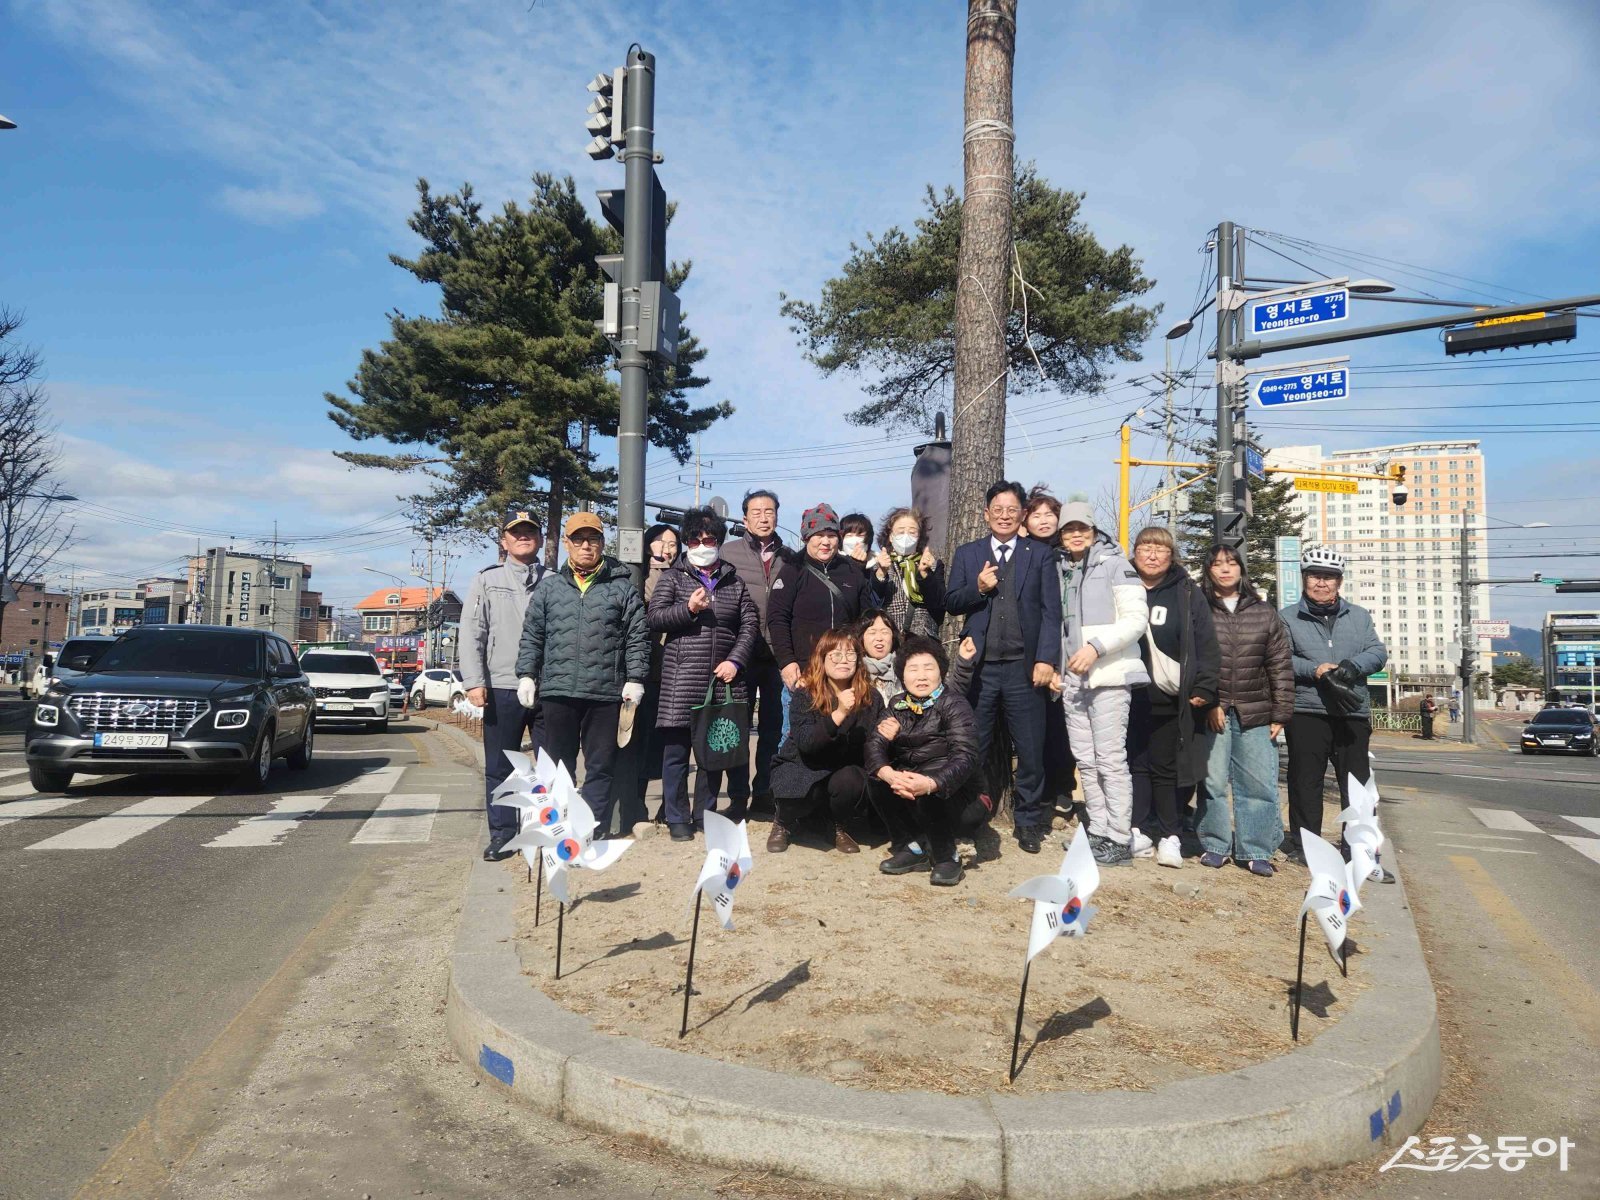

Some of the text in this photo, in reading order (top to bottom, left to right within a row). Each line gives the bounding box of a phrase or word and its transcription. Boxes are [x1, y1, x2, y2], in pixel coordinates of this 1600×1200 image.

[1266, 299, 1312, 319] 영서로
[1261, 313, 1320, 329] Yeongseo-ro
[1300, 372, 1343, 390] 영서로
[1283, 388, 1344, 401] Yeongseo-ro
[1322, 482, 1337, 491] CCTV
[104, 736, 166, 747] 249무 3727
